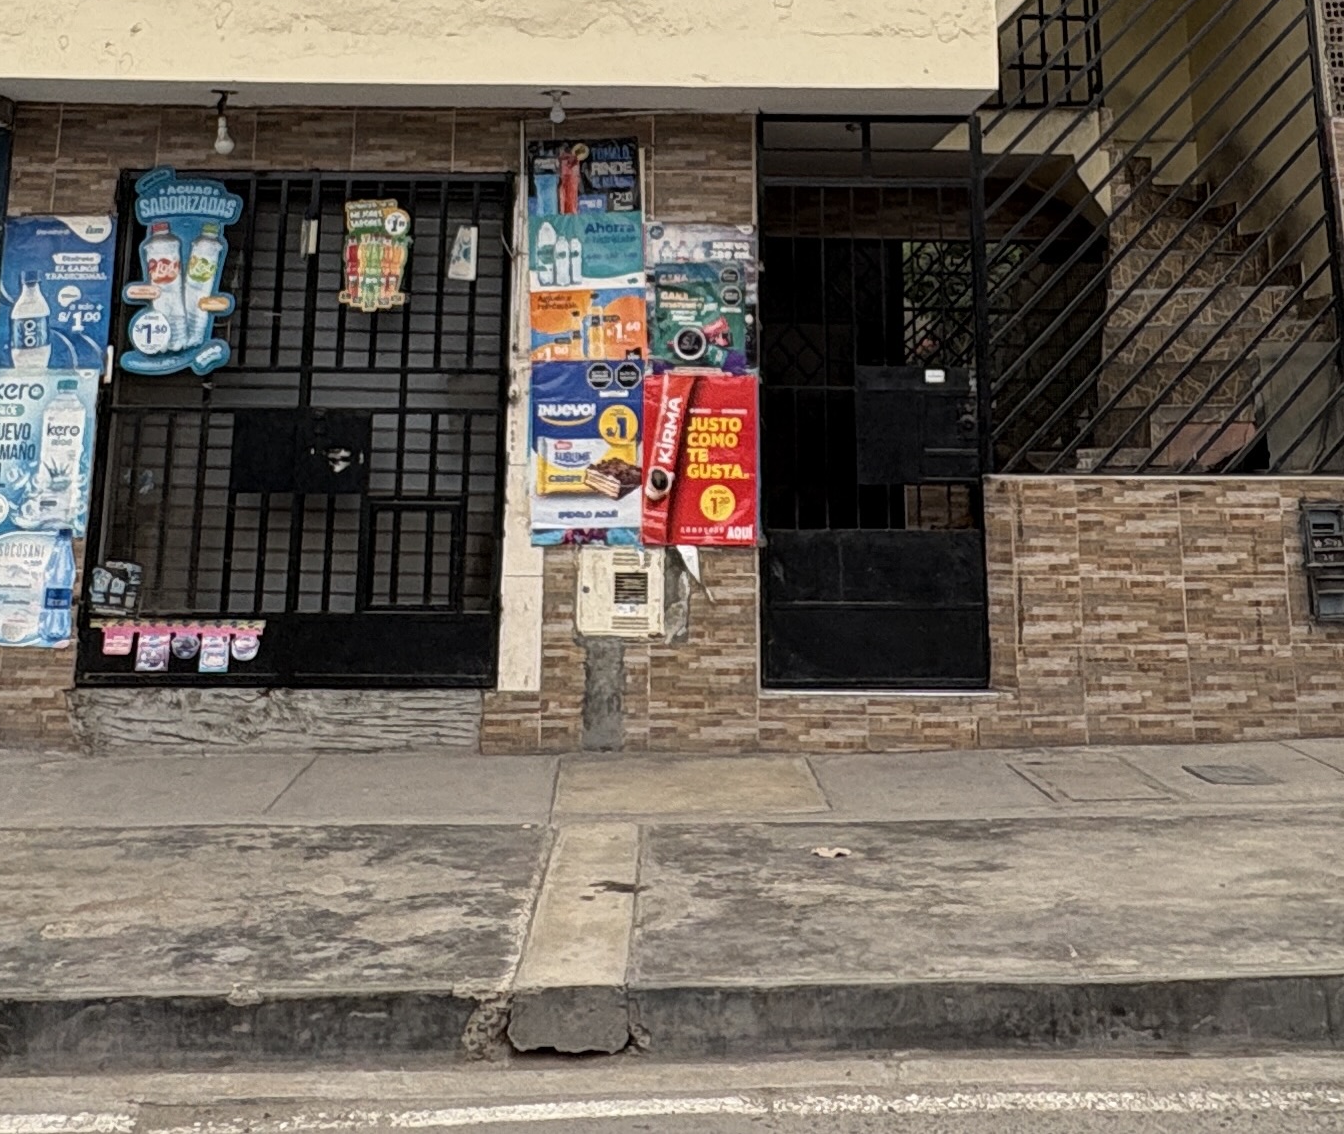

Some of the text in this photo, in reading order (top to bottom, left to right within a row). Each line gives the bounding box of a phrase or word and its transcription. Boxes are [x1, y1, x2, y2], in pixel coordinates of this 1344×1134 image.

[139, 196, 237, 219] SABORIZADAS
[585, 222, 635, 234] Ahorra
[46, 423, 80, 438] kero
[687, 416, 743, 433] JUSTO
[687, 432, 739, 448] COMO
[686, 448, 710, 463] TE
[686, 463, 750, 480] GUSTA.
